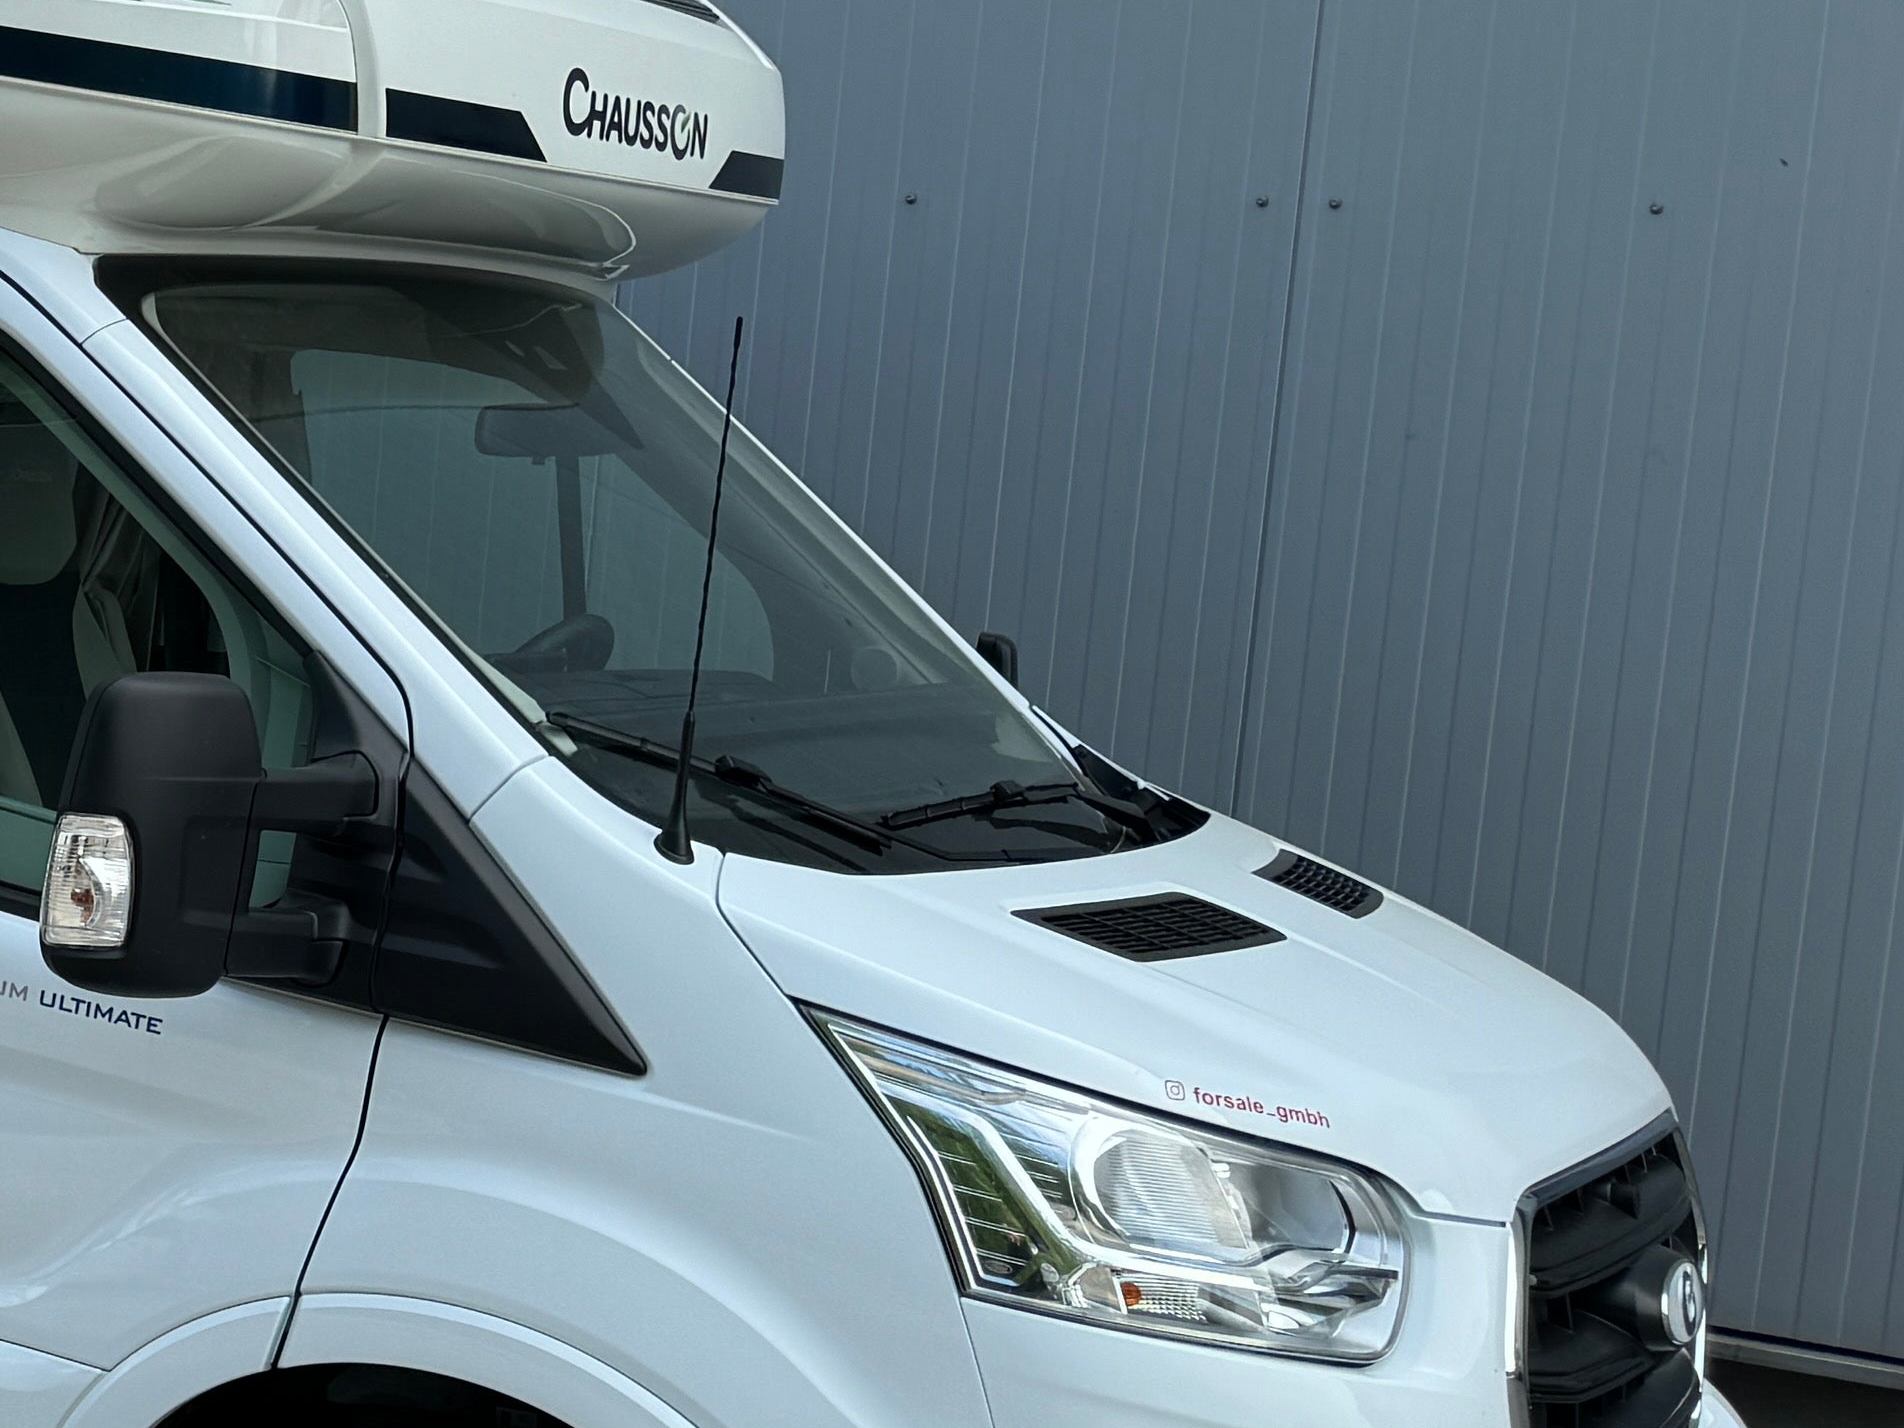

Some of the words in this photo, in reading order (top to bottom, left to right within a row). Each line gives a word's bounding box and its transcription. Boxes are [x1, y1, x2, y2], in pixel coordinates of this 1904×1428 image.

[563, 68, 708, 160] CHAUSSON
[39, 989, 164, 1035] ULTIMATE
[1193, 1086, 1331, 1129] forsale_gmbh
